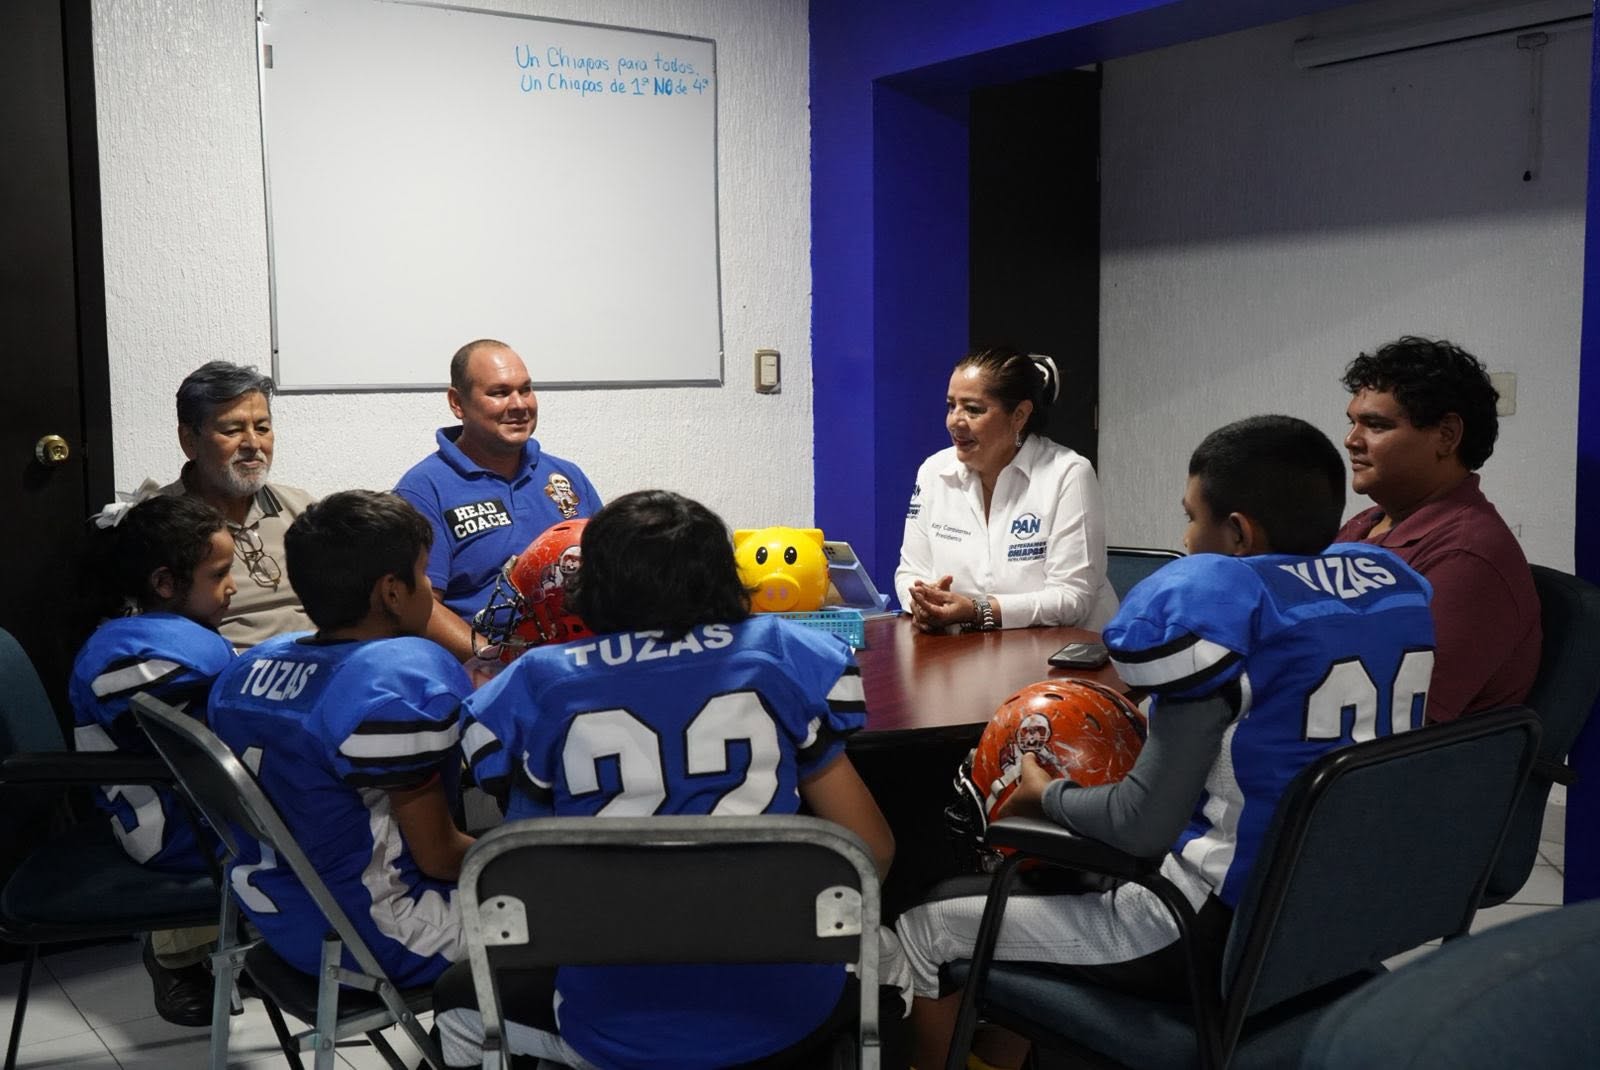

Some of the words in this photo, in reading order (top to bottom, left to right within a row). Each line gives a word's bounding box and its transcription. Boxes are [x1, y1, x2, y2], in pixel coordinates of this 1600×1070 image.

[516, 45, 540, 69] Un
[547, 47, 610, 76] Chiapas
[618, 57, 648, 75] para
[520, 75, 542, 92] Un
[547, 73, 603, 97] Chiapas
[610, 79, 627, 93] de
[653, 77, 673, 96] NO
[675, 79, 688, 93] de
[454, 501, 498, 522] HEAD
[454, 512, 513, 539] COACH
[1010, 518, 1041, 534] PAN
[565, 624, 734, 666] TUZAS
[240, 658, 319, 701] TUZAS
[563, 691, 781, 816] 22
